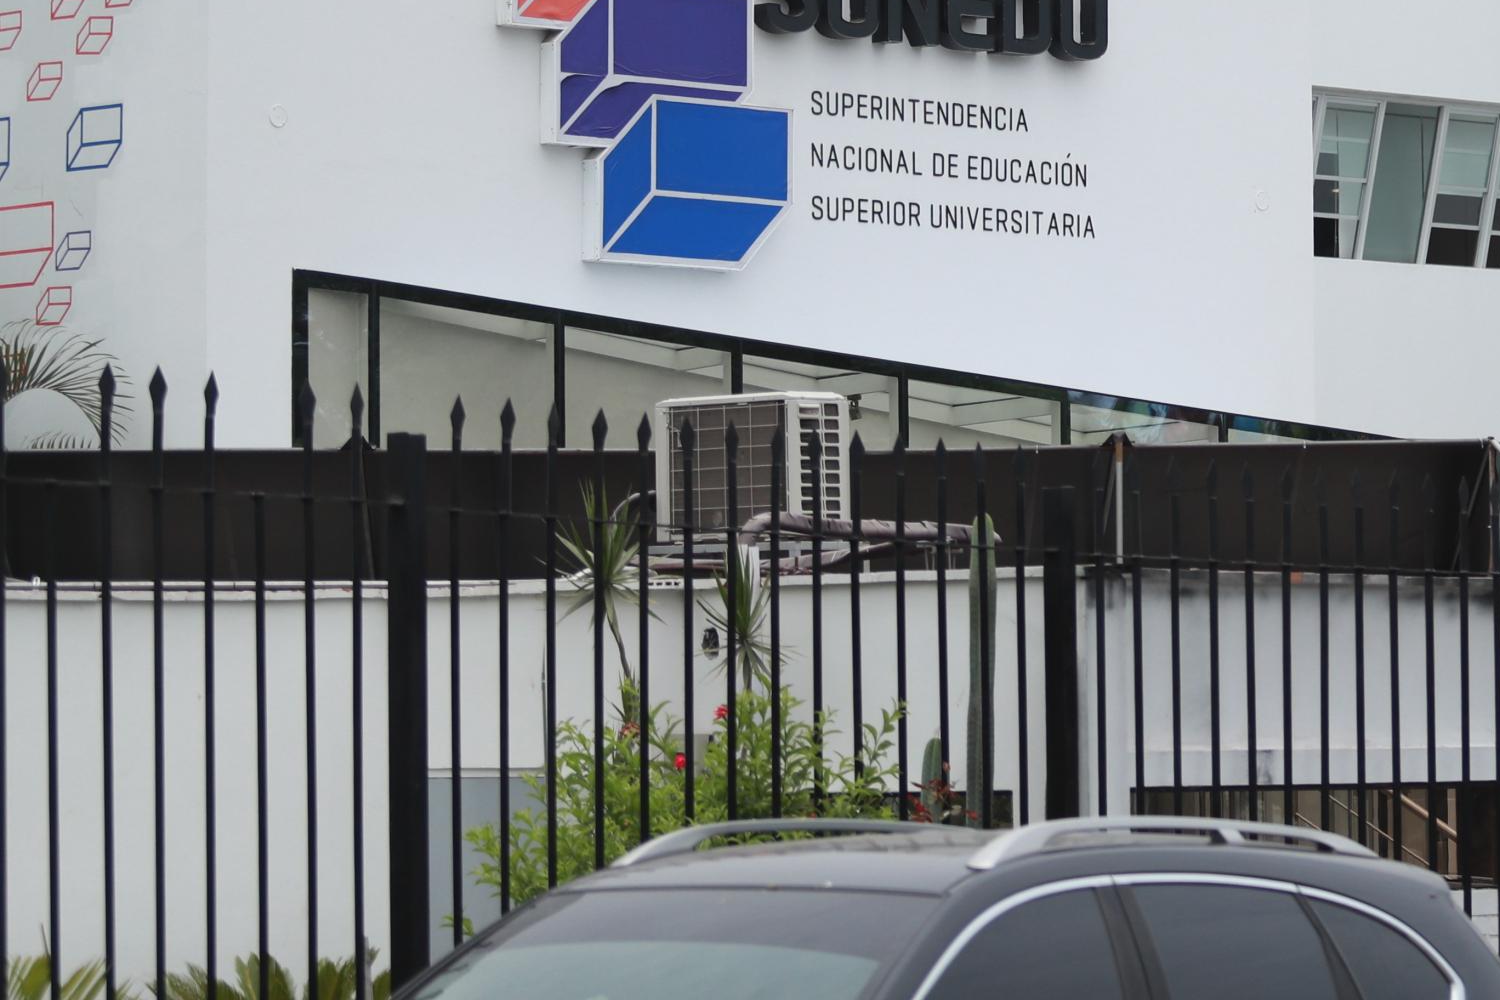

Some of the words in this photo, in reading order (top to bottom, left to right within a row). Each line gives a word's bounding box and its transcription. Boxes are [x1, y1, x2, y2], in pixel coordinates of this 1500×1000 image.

[810, 90, 1028, 132] SUPERINTENDENCIA
[810, 142, 922, 176] NACIONAL
[932, 152, 959, 179] DE
[967, 152, 1088, 188] EDUCACIÓN
[810, 195, 921, 227] SUPERIOR
[930, 203, 1095, 239] UNIVERSITARIA
